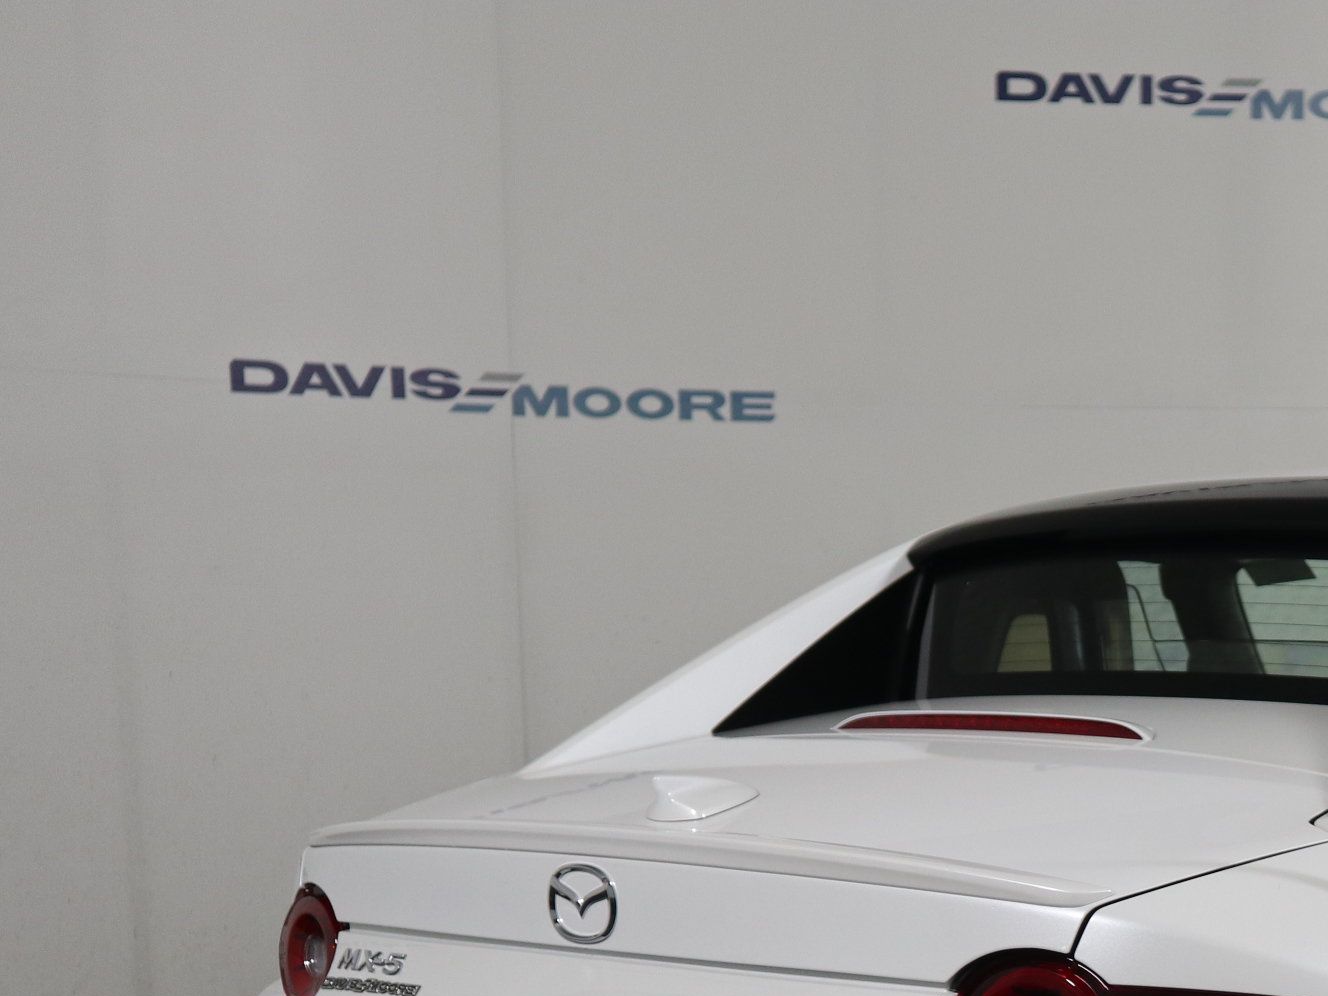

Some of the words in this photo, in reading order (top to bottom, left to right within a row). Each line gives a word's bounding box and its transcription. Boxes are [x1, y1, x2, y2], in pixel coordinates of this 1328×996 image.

[995, 70, 1204, 106] DAVIS
[229, 358, 461, 401] DAVIS
[511, 384, 776, 423] MOORE
[337, 948, 407, 976] MX-5
